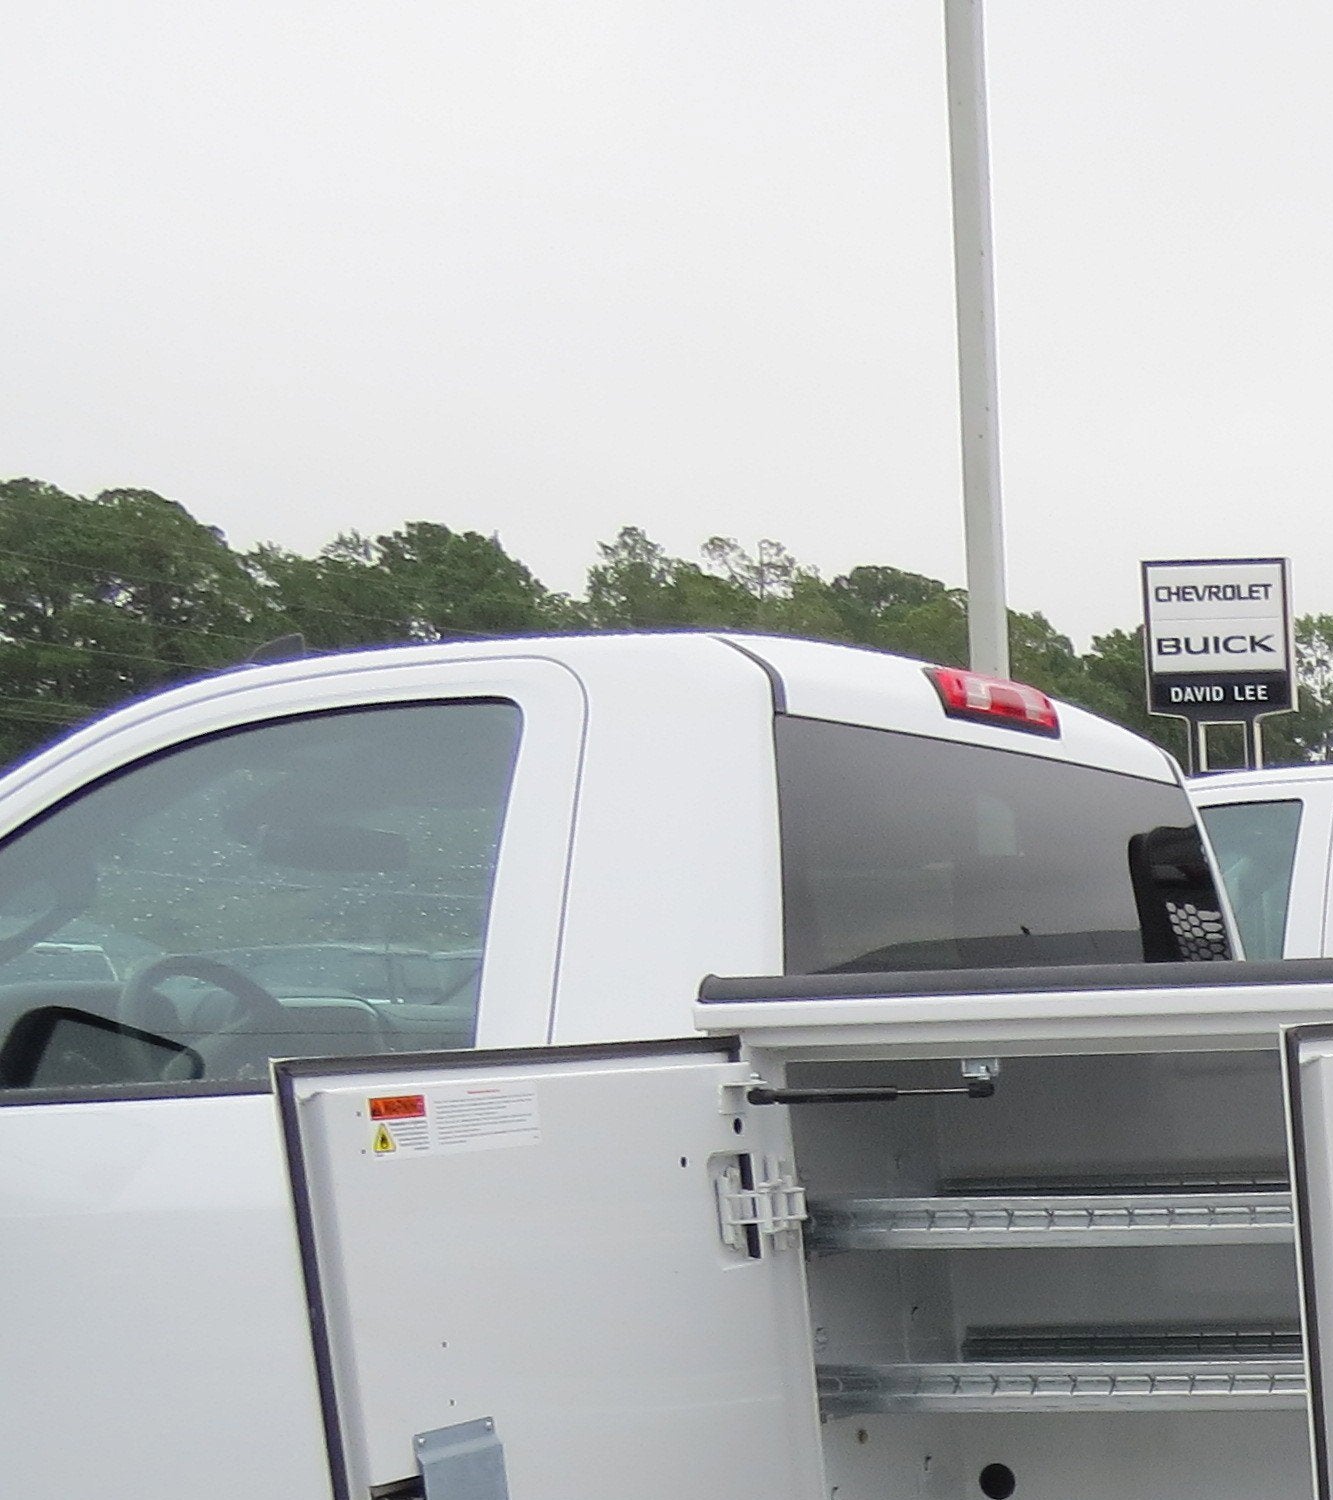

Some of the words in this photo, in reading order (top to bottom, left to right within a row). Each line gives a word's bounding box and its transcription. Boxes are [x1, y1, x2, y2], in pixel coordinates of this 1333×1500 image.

[1155, 583, 1272, 602] CHEVROLET
[1156, 635, 1277, 656] BUICK
[1170, 686, 1224, 703] DAVID
[1234, 685, 1268, 701] LEE
